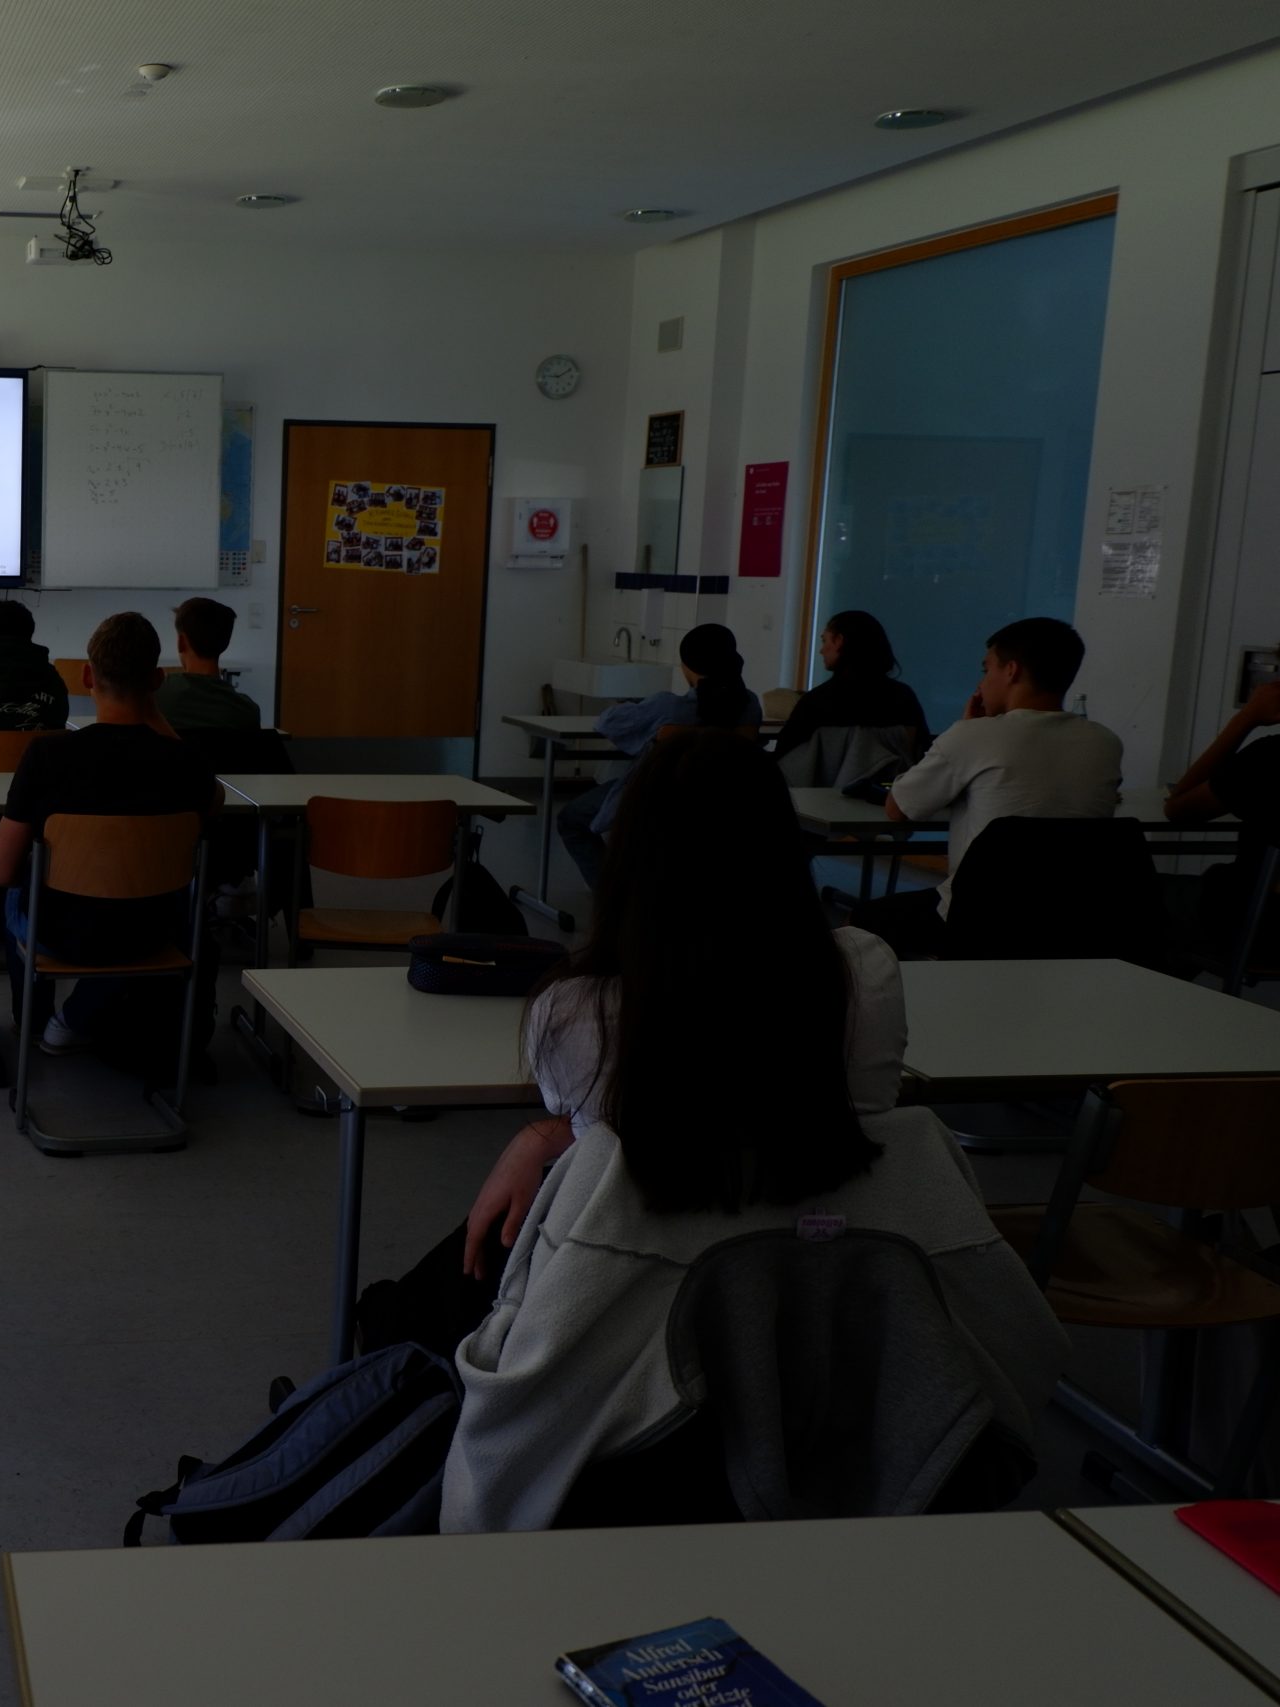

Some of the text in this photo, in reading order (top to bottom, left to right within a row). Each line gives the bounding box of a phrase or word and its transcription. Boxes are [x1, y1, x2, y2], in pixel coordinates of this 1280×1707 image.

[621, 1648, 724, 1681] Andersch
[625, 1638, 693, 1665] Alfred
[642, 1664, 728, 1695] Sansibar
[677, 1681, 718, 1701] oder
[701, 1687, 752, 1707] letzte
